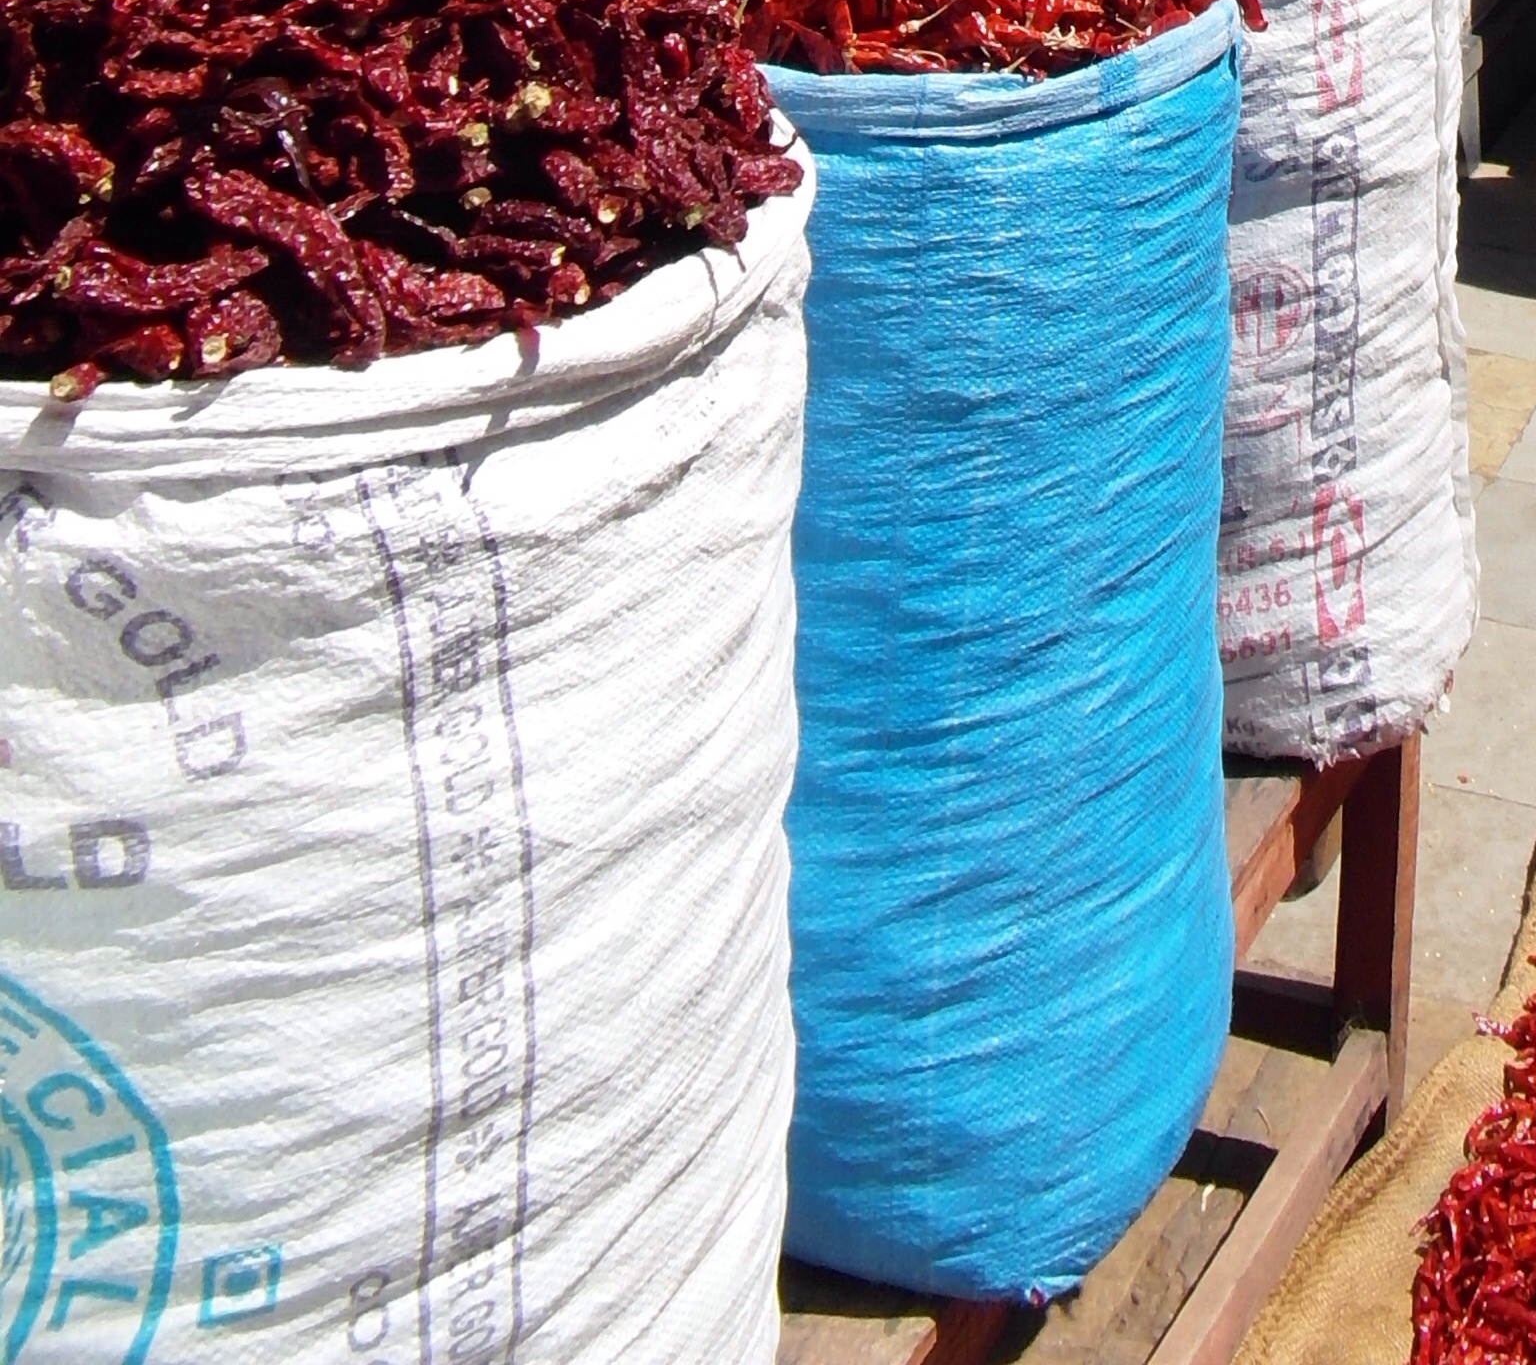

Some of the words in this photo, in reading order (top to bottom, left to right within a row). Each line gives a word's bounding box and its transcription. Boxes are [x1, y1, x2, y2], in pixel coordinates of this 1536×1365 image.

[64, 553, 249, 783] GOLD
[0, 818, 152, 890] LD
[448, 1300, 497, 1365] GO
